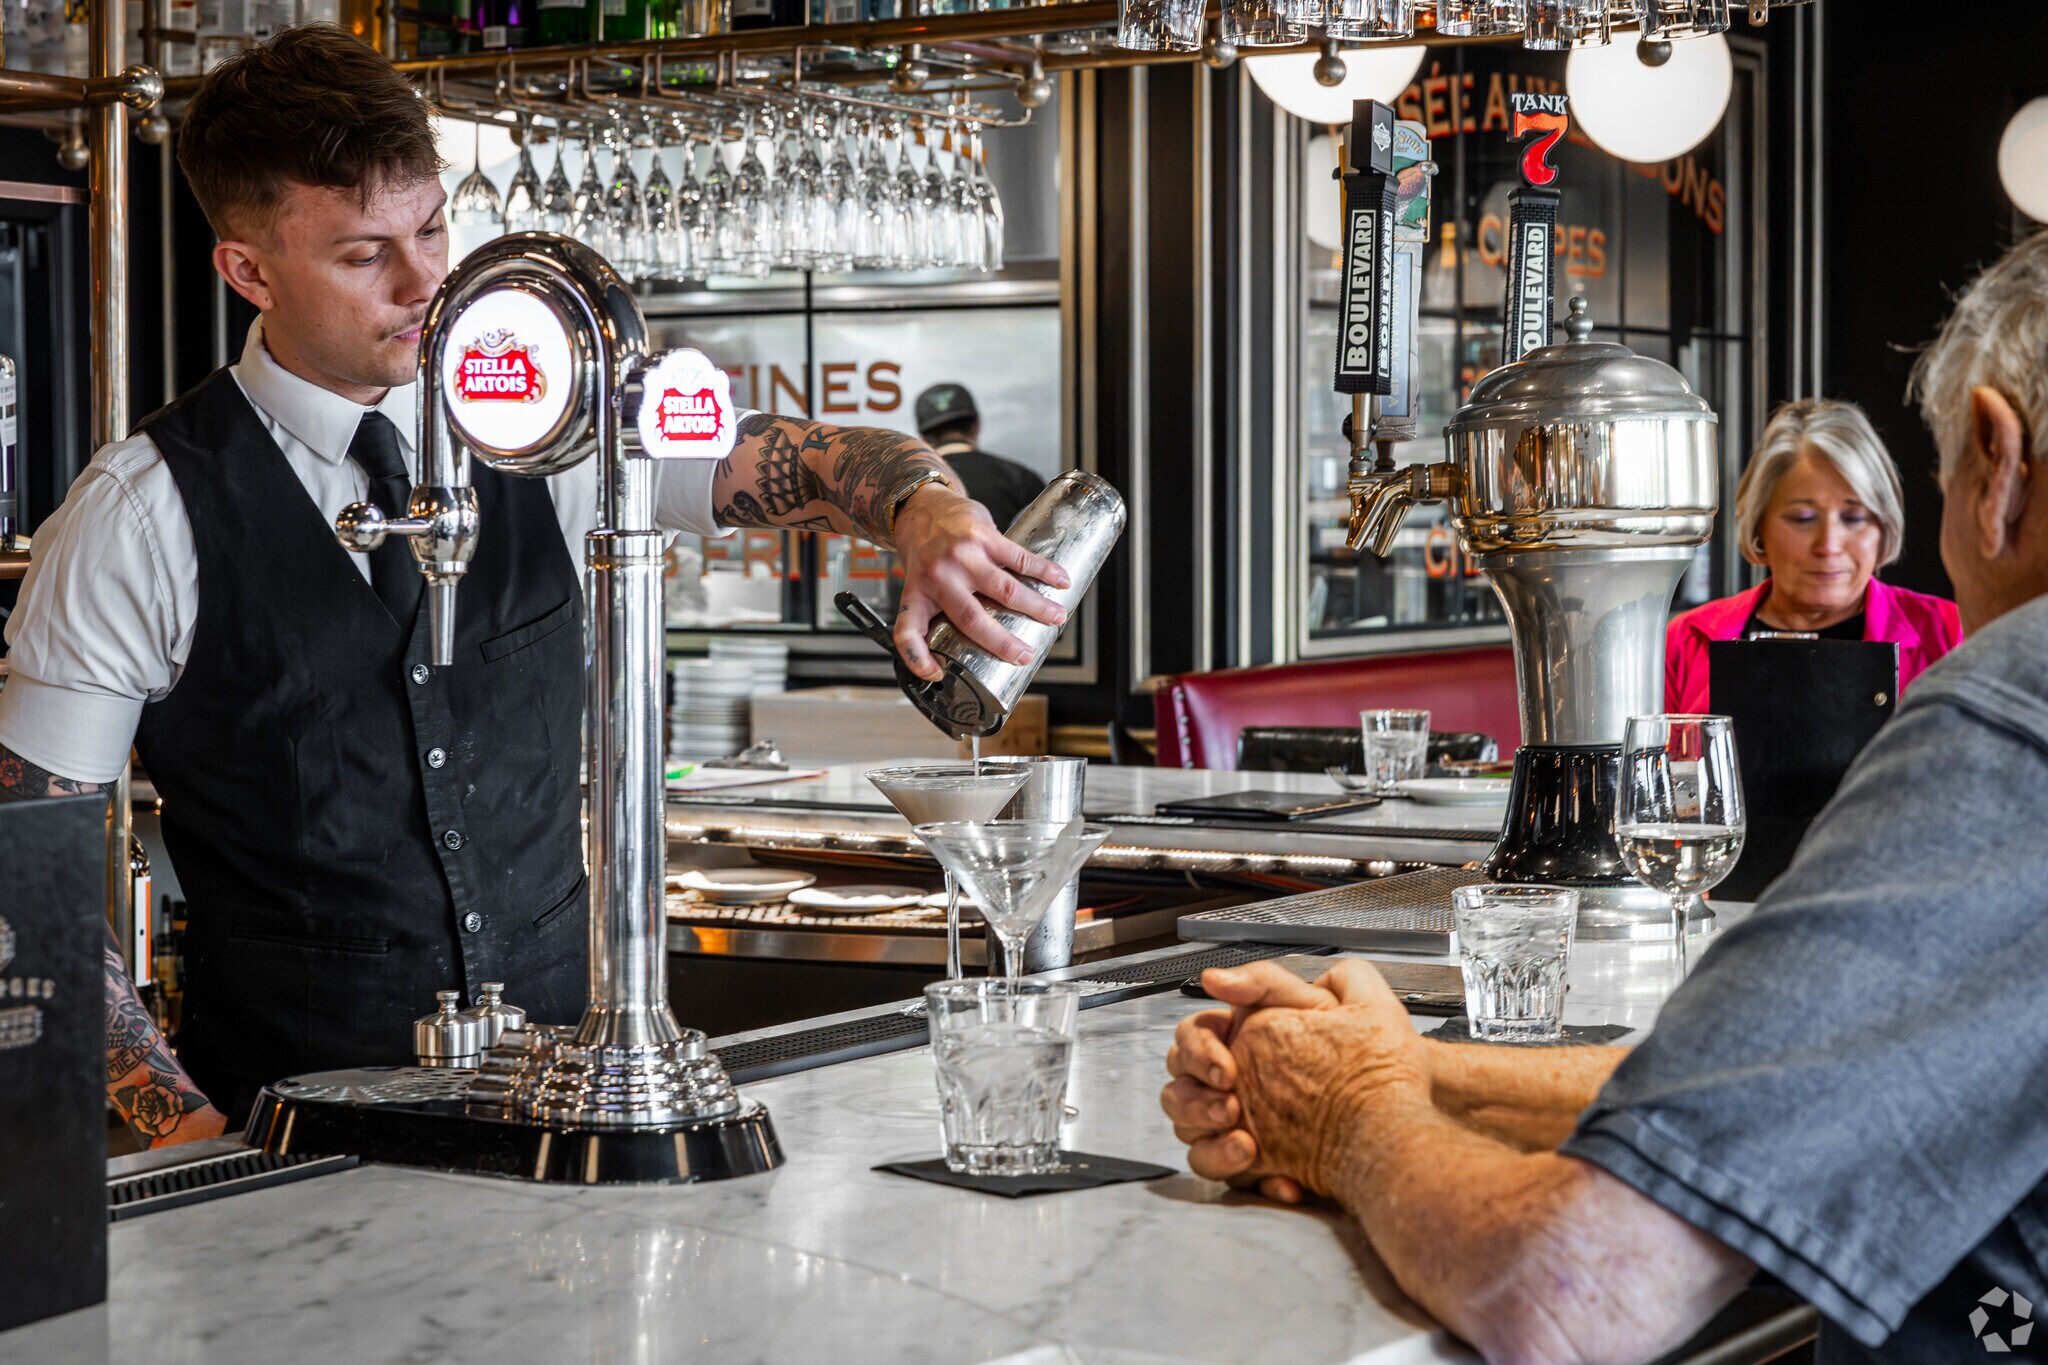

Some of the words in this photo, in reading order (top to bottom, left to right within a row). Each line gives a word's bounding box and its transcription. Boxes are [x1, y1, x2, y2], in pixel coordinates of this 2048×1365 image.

[1511, 92, 1569, 115] TANK
[1513, 111, 1569, 186] 7
[1346, 214, 1372, 369] BOULEVARD
[1380, 216, 1392, 368] BOULEVARD
[1522, 226, 1545, 352] OULEVARD
[464, 357, 526, 375] STELLA
[464, 376, 527, 393] ARTOIS
[663, 396, 716, 415] STELLA
[663, 415, 717, 434] ARTOIS
[700, 528, 906, 579] FRITE
